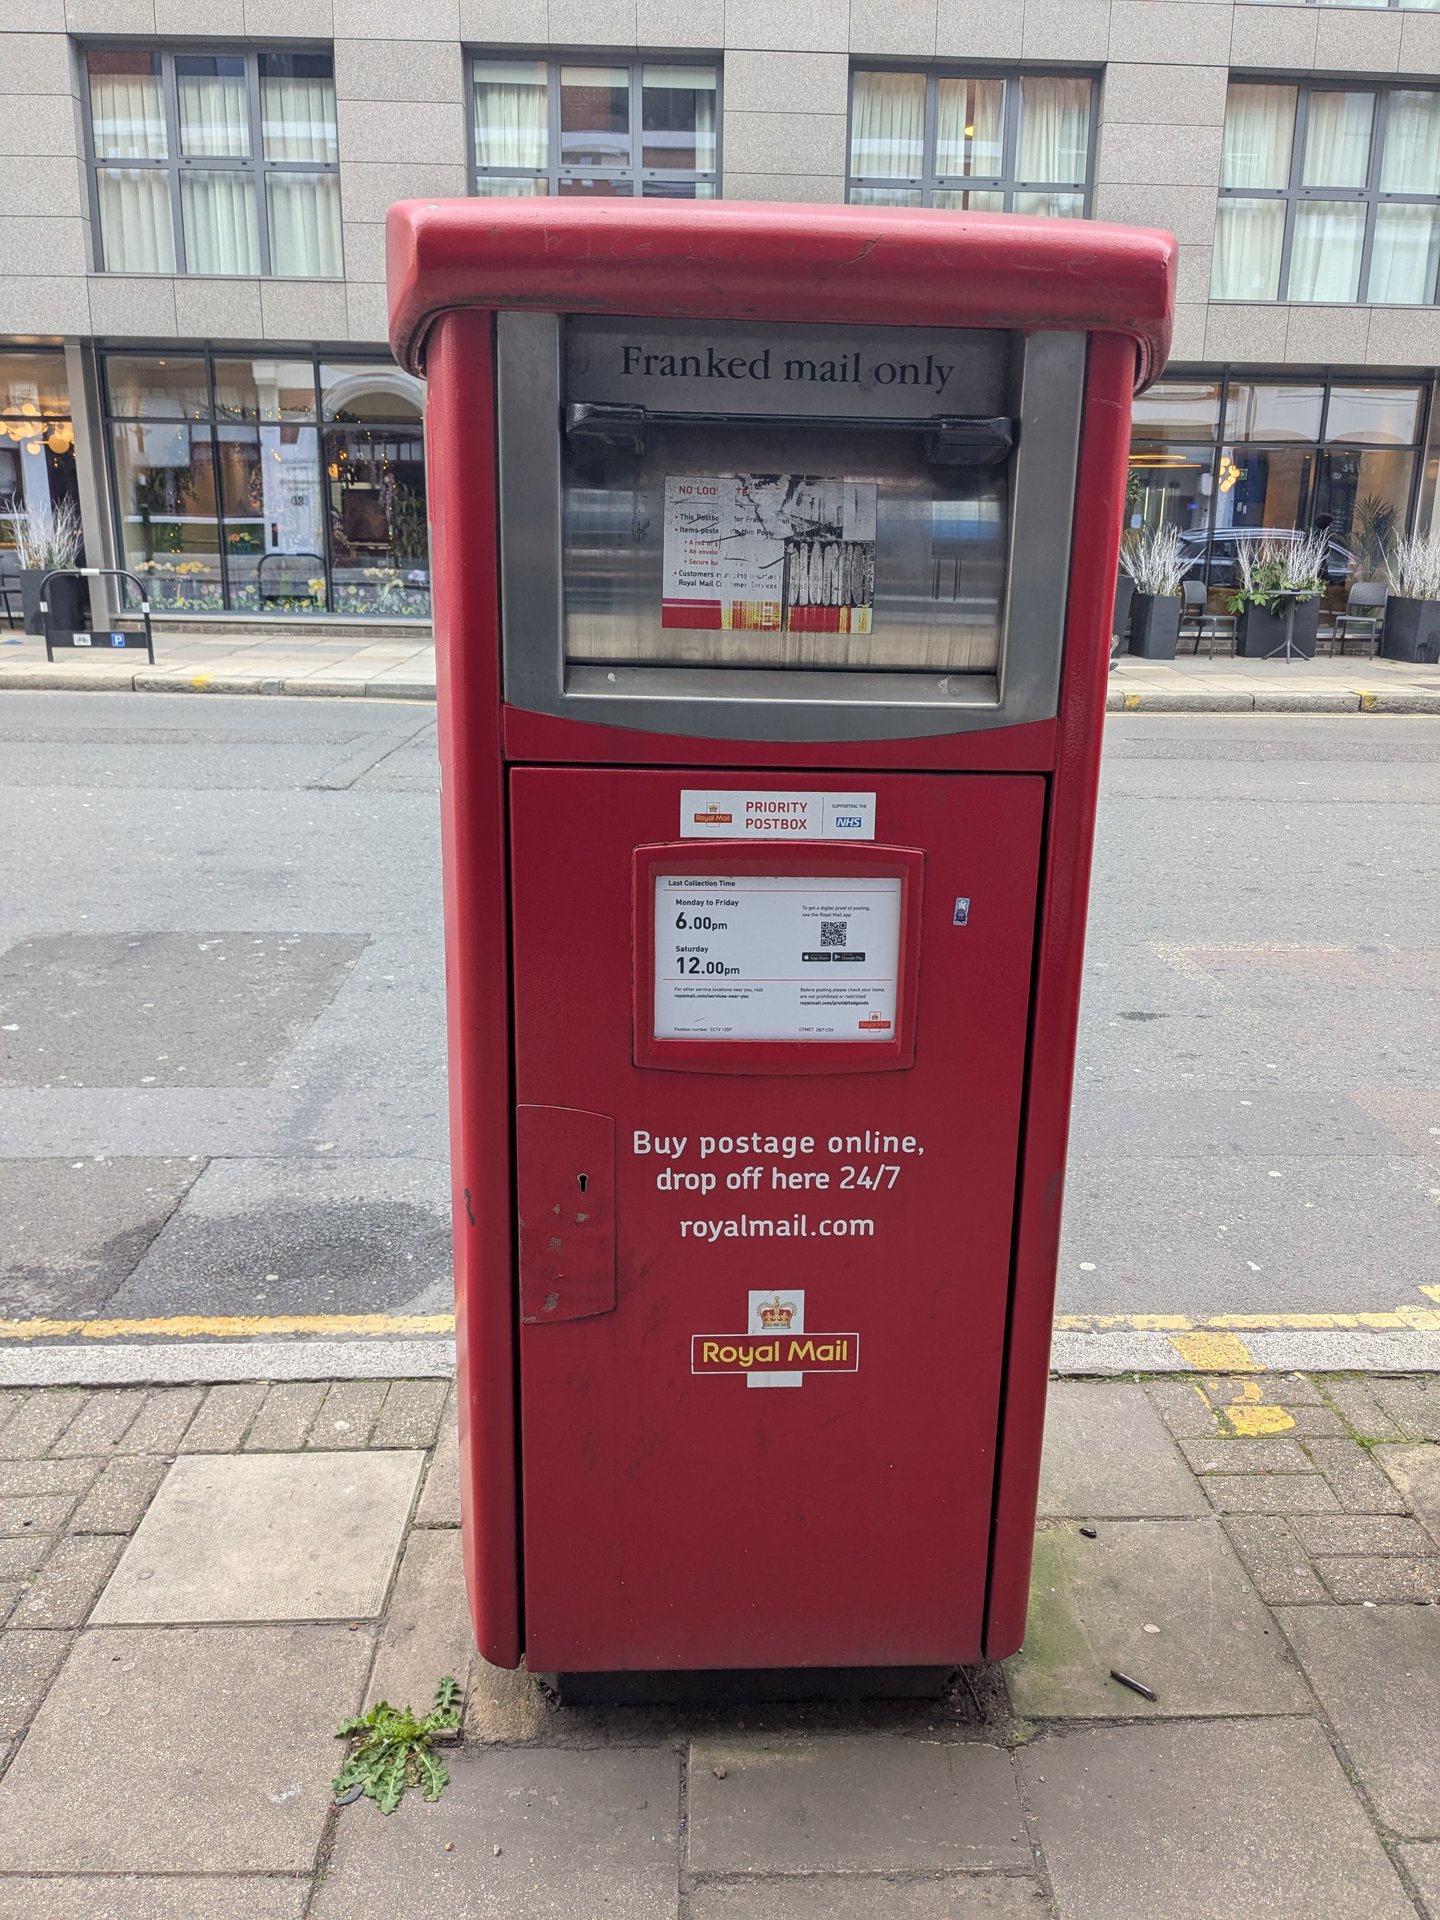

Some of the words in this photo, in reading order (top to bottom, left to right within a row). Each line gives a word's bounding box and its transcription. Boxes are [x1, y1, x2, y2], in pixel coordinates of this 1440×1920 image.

[621, 346, 771, 380] Franked
[784, 352, 861, 383] mail
[874, 354, 955, 394] only
[679, 486, 693, 495] NO
[700, 528, 719, 536] poste
[679, 570, 714, 578] Customers
[679, 580, 696, 588] Royal
[746, 802, 808, 813] PRIORITY
[695, 814, 714, 822] Royal
[837, 818, 861, 826] NHS
[746, 819, 807, 830] POSTBOX
[676, 899, 704, 907] Monday
[716, 899, 739, 907] Friday
[675, 912, 728, 931] 6.00pm
[675, 945, 708, 954] Saturday
[676, 957, 740, 976] 12.00pm
[633, 1130, 688, 1159] Buy
[700, 1132, 815, 1159] postage
[828, 1130, 924, 1156] online,
[656, 1167, 716, 1195] drop
[726, 1166, 764, 1190] off
[772, 1166, 830, 1190] here
[839, 1164, 901, 1191] 24/7
[680, 1213, 875, 1242] royalmail.com
[703, 1341, 780, 1368] Royal
[788, 1340, 848, 1362] Mail
